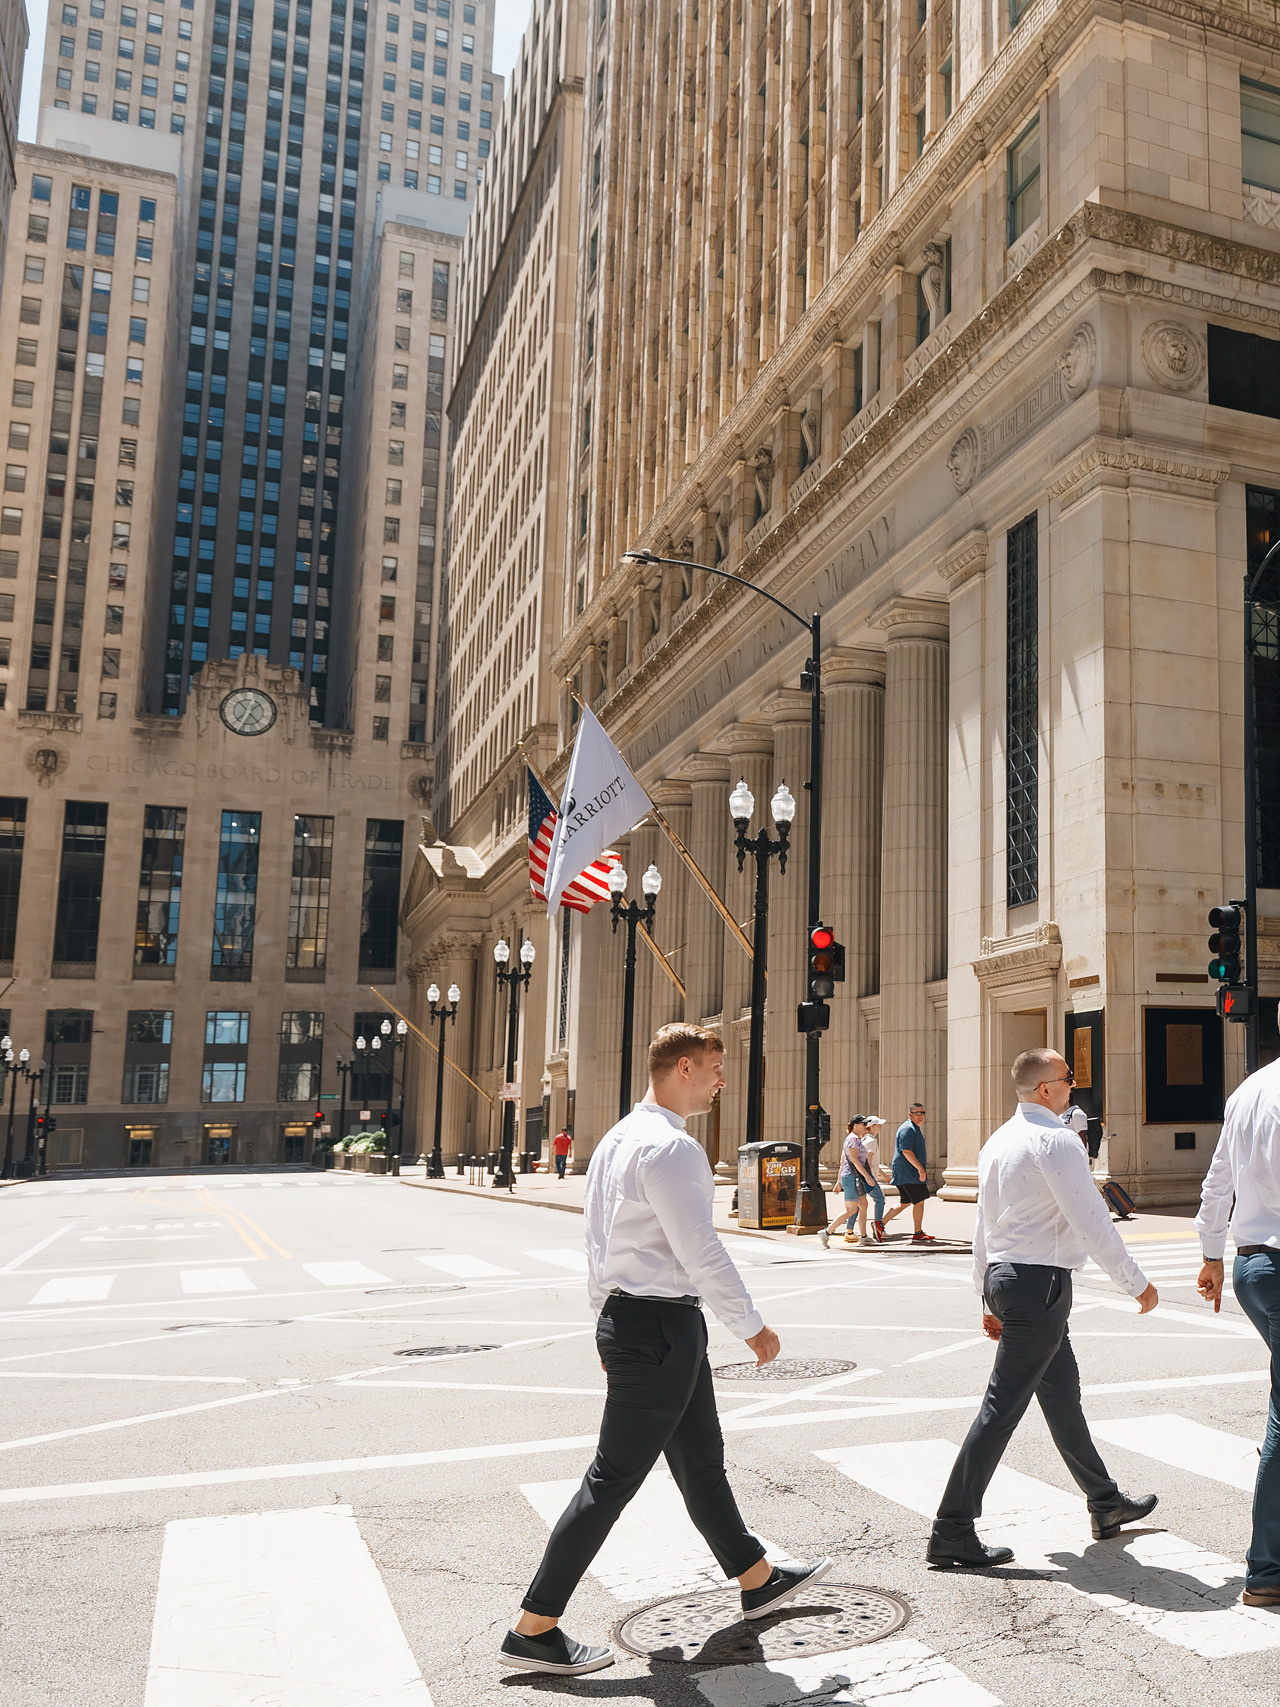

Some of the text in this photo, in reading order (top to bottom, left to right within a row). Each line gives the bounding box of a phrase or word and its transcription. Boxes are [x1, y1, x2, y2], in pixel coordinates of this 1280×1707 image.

[715, 645, 743, 697] AND
[801, 506, 894, 621] COMPANY
[86, 754, 395, 792] CHICAGO BOARD OF TRADE
